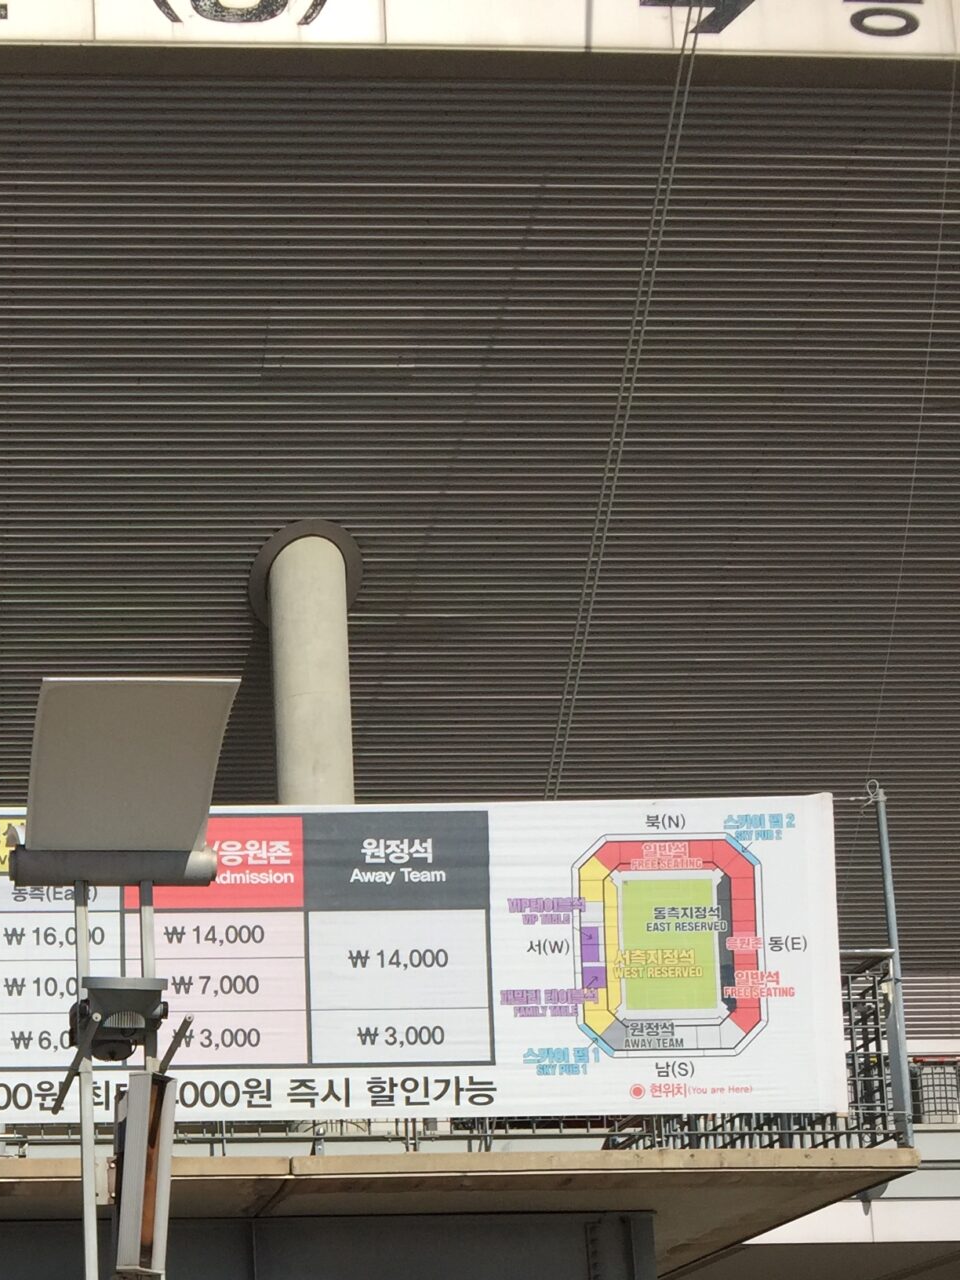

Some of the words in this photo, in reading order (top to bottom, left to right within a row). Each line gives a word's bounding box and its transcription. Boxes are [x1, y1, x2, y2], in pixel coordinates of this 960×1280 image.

[646, 814, 685, 830] 북(N)
[785, 813, 796, 828] 2
[360, 838, 433, 864] 원정석
[642, 842, 689, 858] 일반석
[630, 858, 657, 870] FREE
[658, 858, 703, 869] SEATING
[350, 869, 395, 884] Away
[400, 868, 445, 882] Team
[10, 885, 99, 905] 동측(Eat)
[522, 914, 539, 925] VIP
[653, 906, 722, 920] 동측지정석
[646, 921, 672, 932] EAST
[674, 921, 728, 932] RESERVED
[527, 939, 569, 955] 서(W)
[769, 936, 807, 951] 동(E)
[614, 949, 695, 966] 서측지정석
[613, 967, 643, 979] WEST
[647, 967, 703, 978] RESERVED
[734, 970, 780, 986] 일반석
[724, 986, 752, 998] FREE
[753, 986, 795, 998] SEATING
[629, 1022, 675, 1036] 원정석
[624, 1037, 653, 1048] AWAY
[656, 1037, 684, 1048] TEAM
[536, 1064, 556, 1075] SKY
[656, 1061, 694, 1078] 남(S)
[176, 1076, 276, 1110] 000원
[287, 1078, 350, 1108] 즉시
[364, 1073, 502, 1110] 할인가능
[710, 1086, 725, 1094] are
[728, 1084, 753, 1094] Here)
